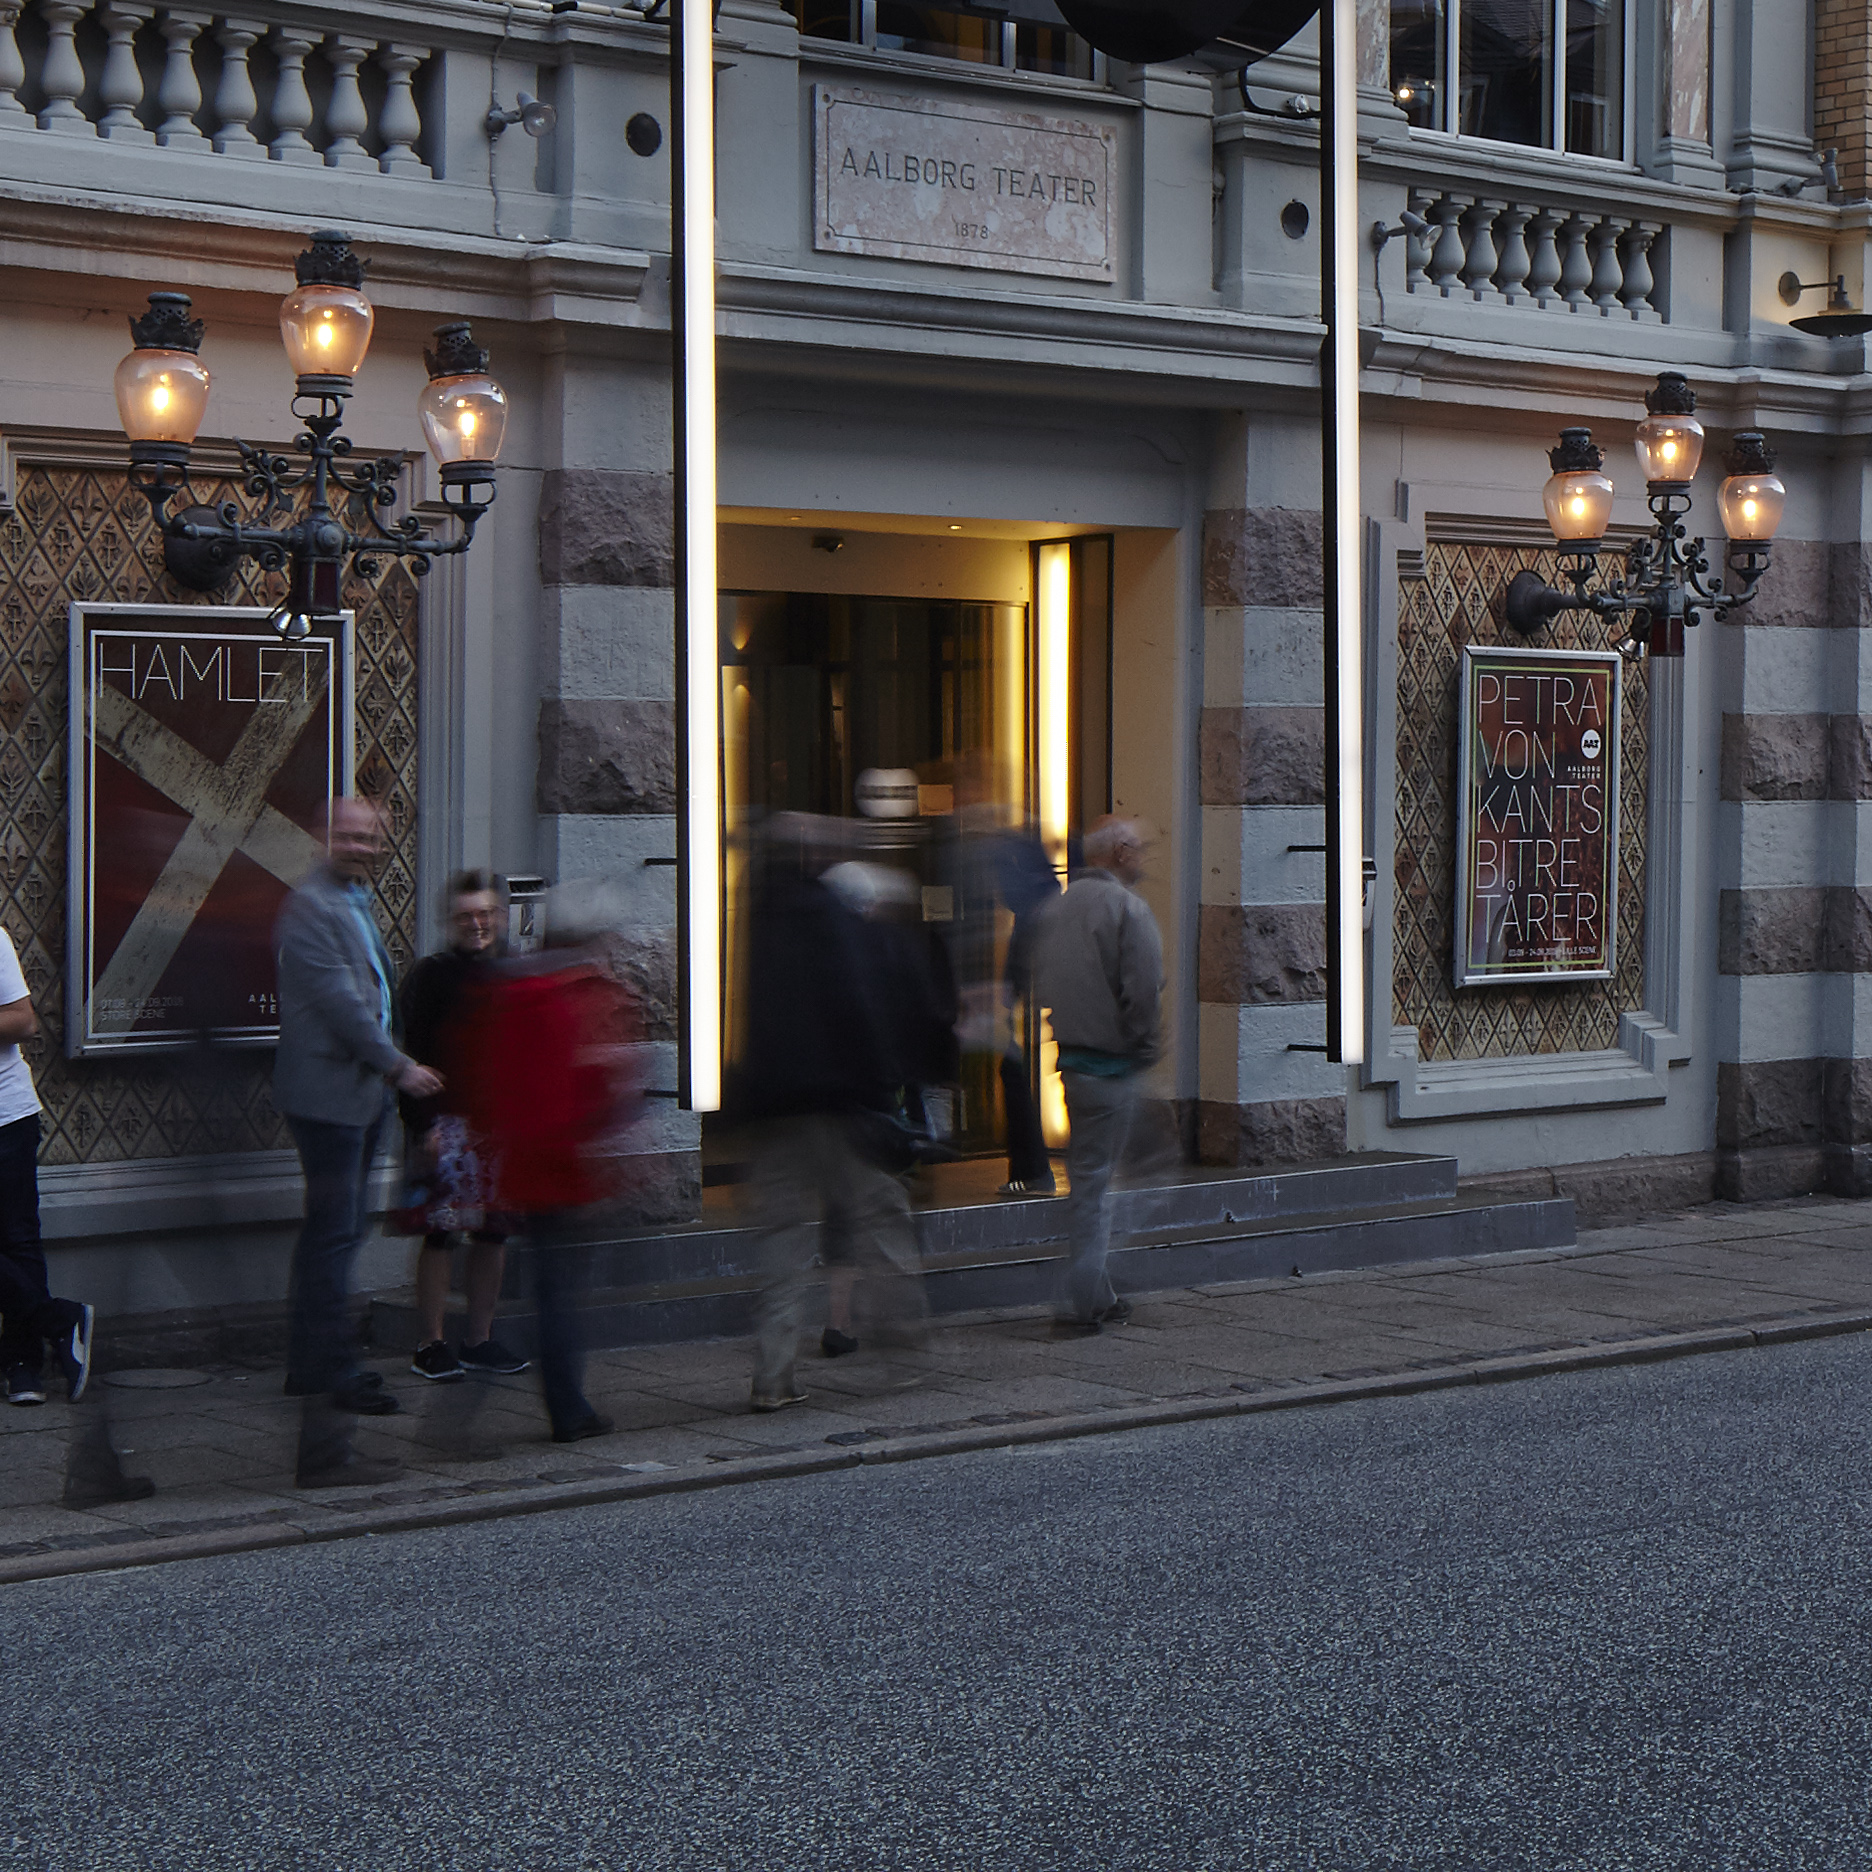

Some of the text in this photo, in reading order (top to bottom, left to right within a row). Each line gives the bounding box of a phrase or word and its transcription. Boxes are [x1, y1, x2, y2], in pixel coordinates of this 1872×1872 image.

[840, 147, 1097, 208] AALBORG TEATER
[953, 221, 990, 240] 1878
[99, 642, 324, 703] HAMLET
[1479, 674, 1602, 726] PETRA
[1479, 729, 1556, 780] VON
[1478, 784, 1602, 834] KANTS
[1476, 838, 1581, 889] BITRE
[1475, 879, 1598, 943] TÅRER
